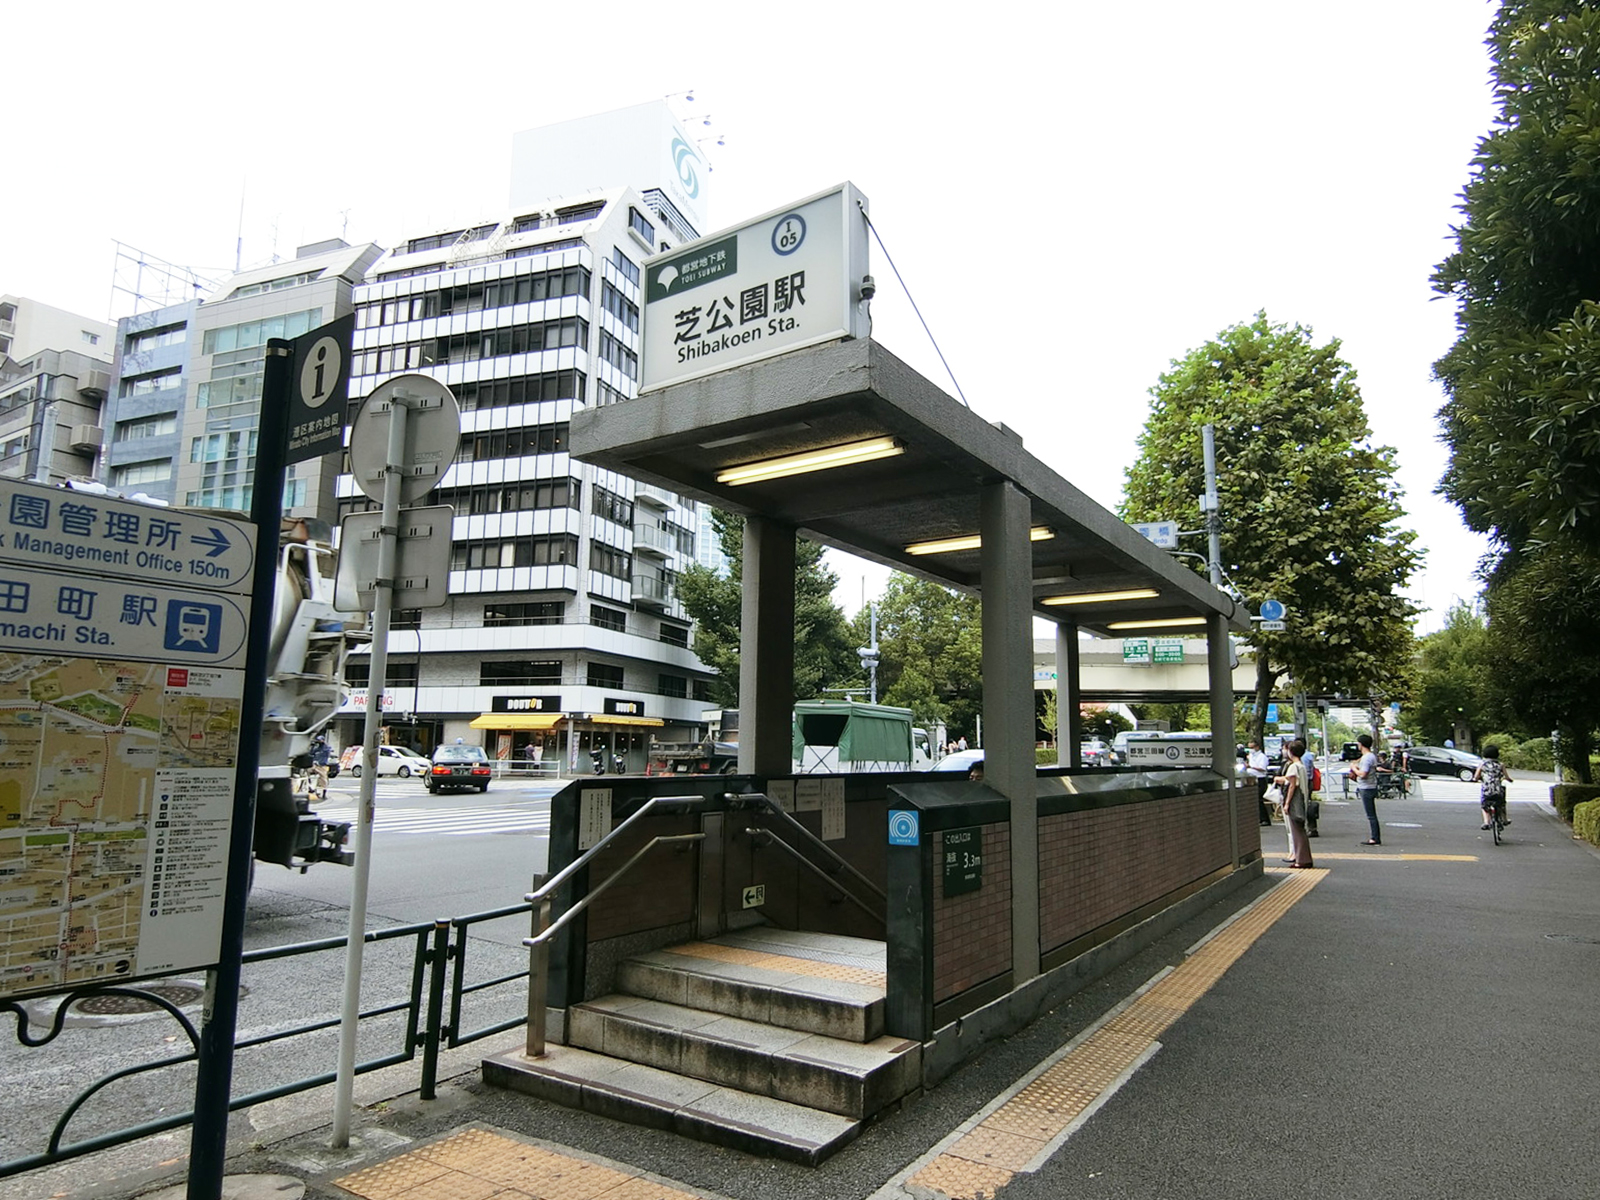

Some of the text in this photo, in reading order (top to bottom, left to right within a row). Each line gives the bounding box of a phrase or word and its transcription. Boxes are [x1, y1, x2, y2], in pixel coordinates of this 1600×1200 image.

[780, 234, 798, 249] 05
[681, 250, 726, 274] 都営地下鉄
[681, 262, 727, 284] TOEI SUBWAY
[674, 270, 806, 345] 芝公園駅
[678, 317, 800, 364] Shibakoen Sta.
[292, 412, 340, 436] 港区案内地図
[14, 532, 130, 566] Management
[136, 551, 182, 572] Office
[188, 560, 230, 580] 150m
[75, 626, 116, 646] Sta.
[507, 698, 542, 710] DOUTOR
[945, 832, 971, 845] この出入口は
[963, 852, 981, 868] 3.3m
